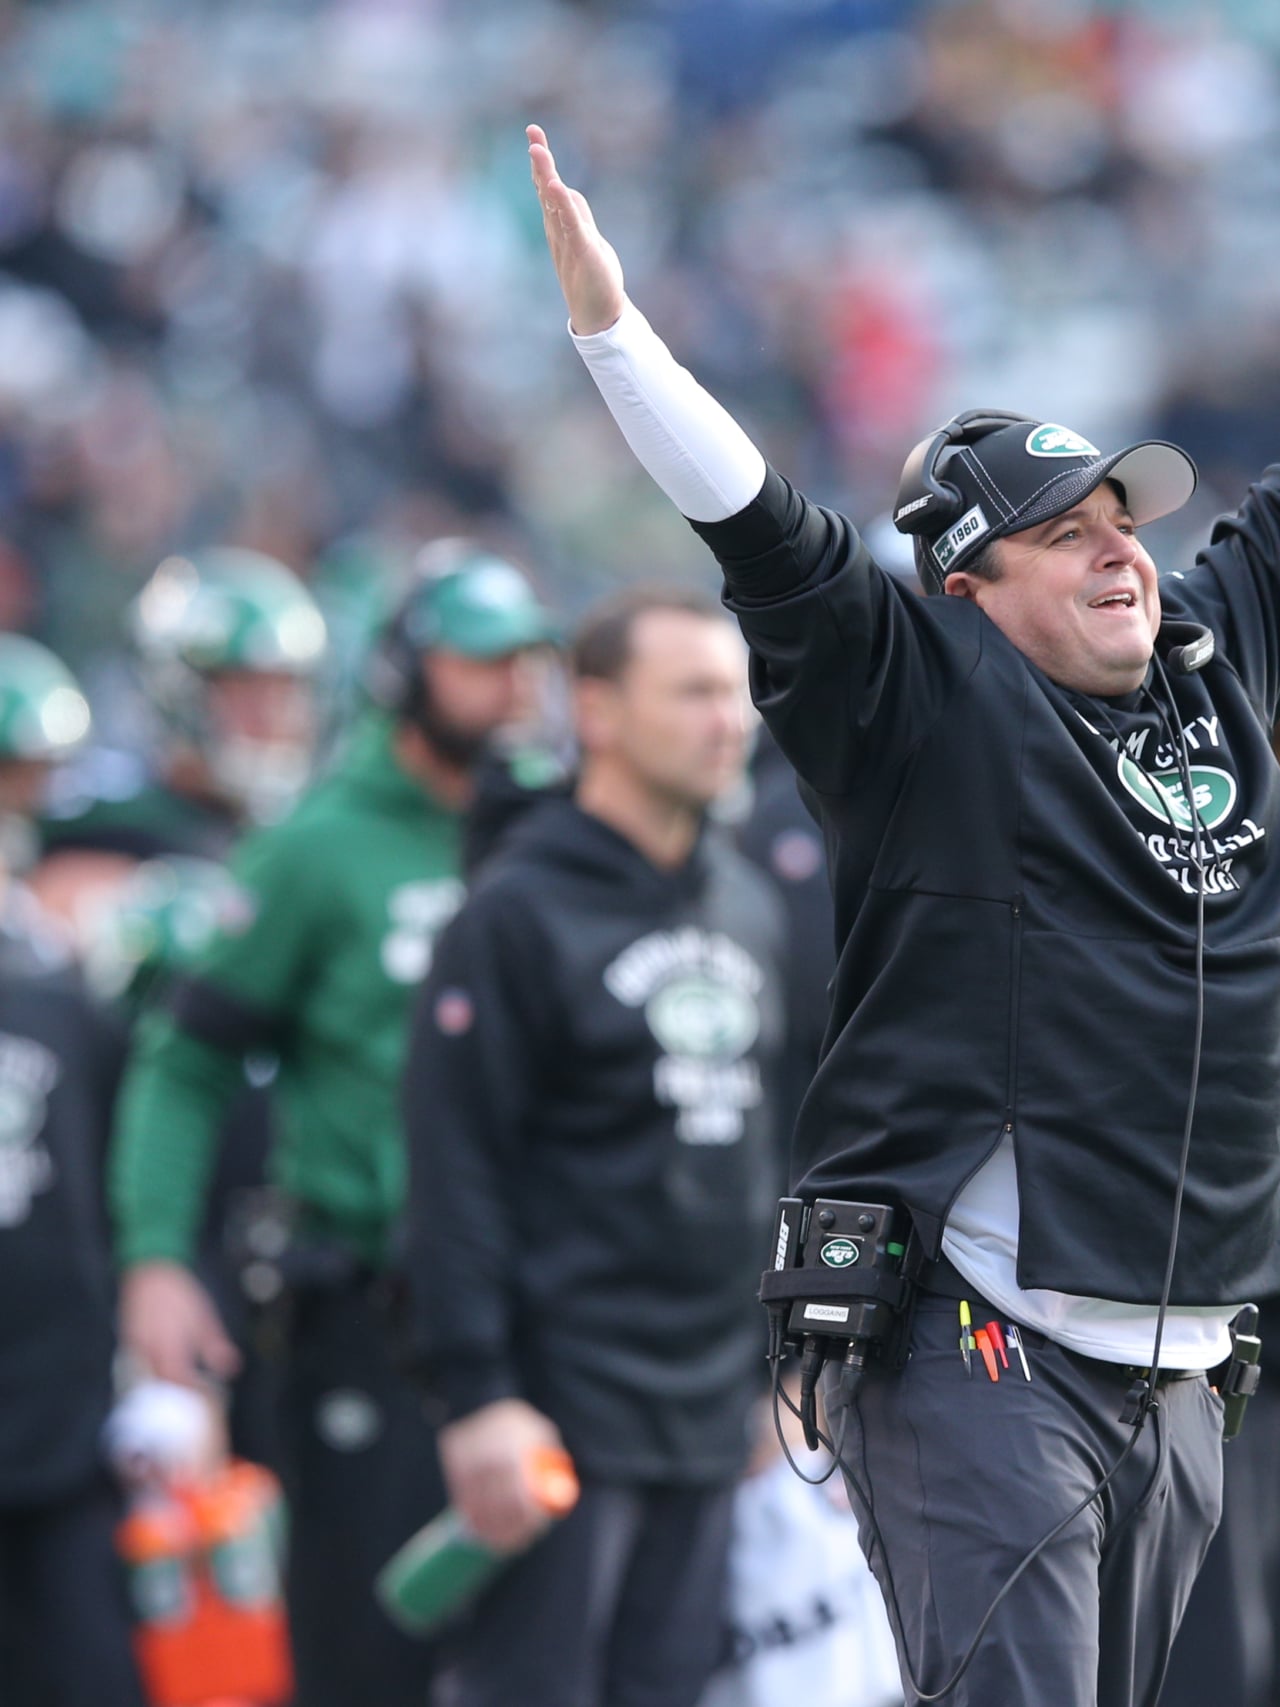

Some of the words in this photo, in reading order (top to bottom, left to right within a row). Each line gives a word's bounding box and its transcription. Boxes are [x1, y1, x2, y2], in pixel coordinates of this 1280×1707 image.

[895, 494, 934, 522] BOSE
[951, 516, 979, 546] 1960
[775, 1209, 789, 1271] BOS
